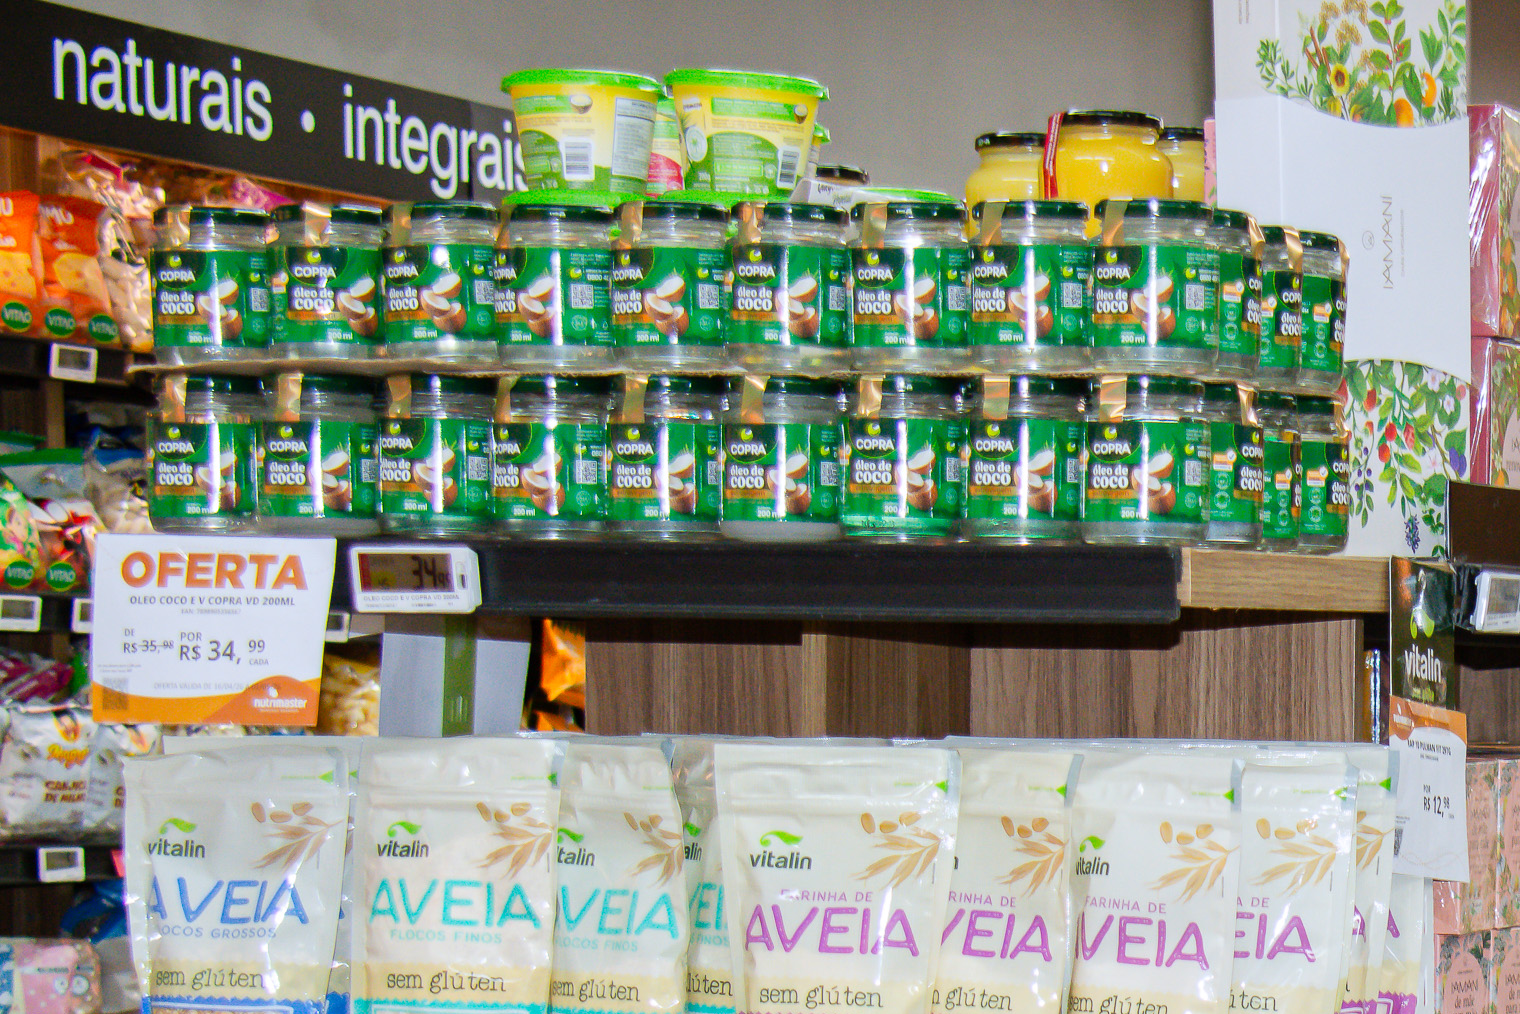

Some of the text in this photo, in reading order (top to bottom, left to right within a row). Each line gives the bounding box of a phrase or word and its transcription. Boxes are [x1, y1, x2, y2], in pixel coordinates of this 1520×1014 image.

[53, 37, 273, 141] naturais
[160, 270, 195, 283] COPRA
[294, 266, 336, 280] COPRA
[388, 266, 418, 279] COPRA
[614, 268, 643, 281] COPRA
[739, 265, 774, 277] COPRA
[858, 267, 893, 281] COPRA
[974, 266, 1007, 280] COPRA
[1097, 266, 1131, 280] COPRA
[382, 437, 413, 449] COPRA
[121, 551, 308, 591] OFERTA
[130, 596, 157, 605] OLEO
[160, 596, 187, 605] COCO
[208, 597, 243, 606] COPRA
[246, 597, 260, 606] VD
[263, 597, 295, 606] 200ML
[124, 629, 135, 637] DE
[180, 632, 202, 641] POR
[123, 642, 138, 654] R$
[180, 645, 201, 662] R$
[248, 640, 265, 653] 99
[249, 658, 269, 666] CADA
[1404, 643, 1442, 683] vitalin
[253, 697, 307, 709] nutrimaster
[147, 836, 206, 859] vitalin
[377, 842, 429, 858] vitalin
[749, 851, 812, 870] vitalin
[780, 889, 873, 903] FARINHA DE
[948, 891, 1016, 908] RINHA DE
[369, 879, 541, 929] AVEIA
[557, 885, 679, 940] VEIA
[211, 928, 276, 939] GROSSOS
[390, 929, 502, 944] FLOCOS FINOS
[746, 904, 919, 957] AVEIA
[156, 970, 265, 992] sem glúten
[387, 971, 506, 993] sem glúten
[552, 975, 640, 1002] sem glúten
[760, 986, 884, 1009] sem glúten
[946, 986, 1012, 1012] glúten
